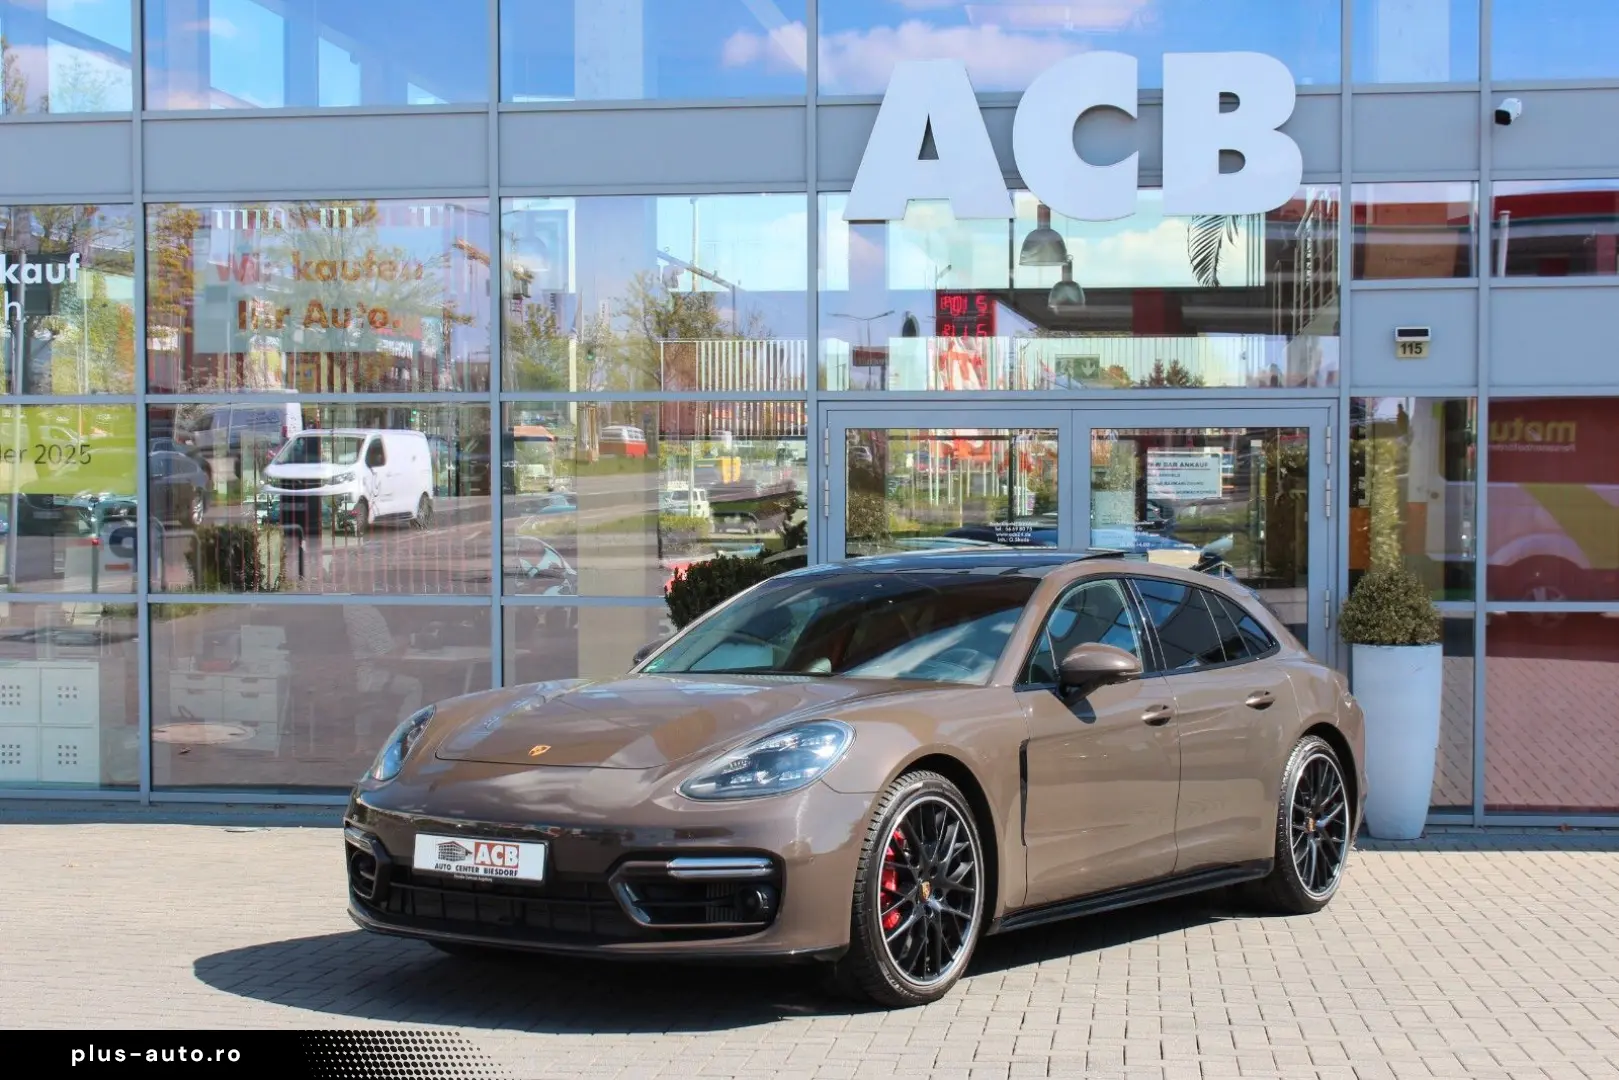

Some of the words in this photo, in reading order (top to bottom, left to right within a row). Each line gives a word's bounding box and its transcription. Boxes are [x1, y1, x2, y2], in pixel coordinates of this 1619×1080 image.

[842, 51, 1303, 221] ACB
[0, 253, 80, 284] kauf
[291, 247, 424, 282] kaufen
[303, 298, 401, 329] Auto.
[1401, 342, 1423, 355] 115
[0, 446, 27, 465] er
[34, 444, 92, 465] 2025
[475, 842, 519, 867] ACB
[434, 863, 452, 871] AUTO
[455, 865, 480, 874] CENTER
[483, 868, 518, 877] BIESDORF
